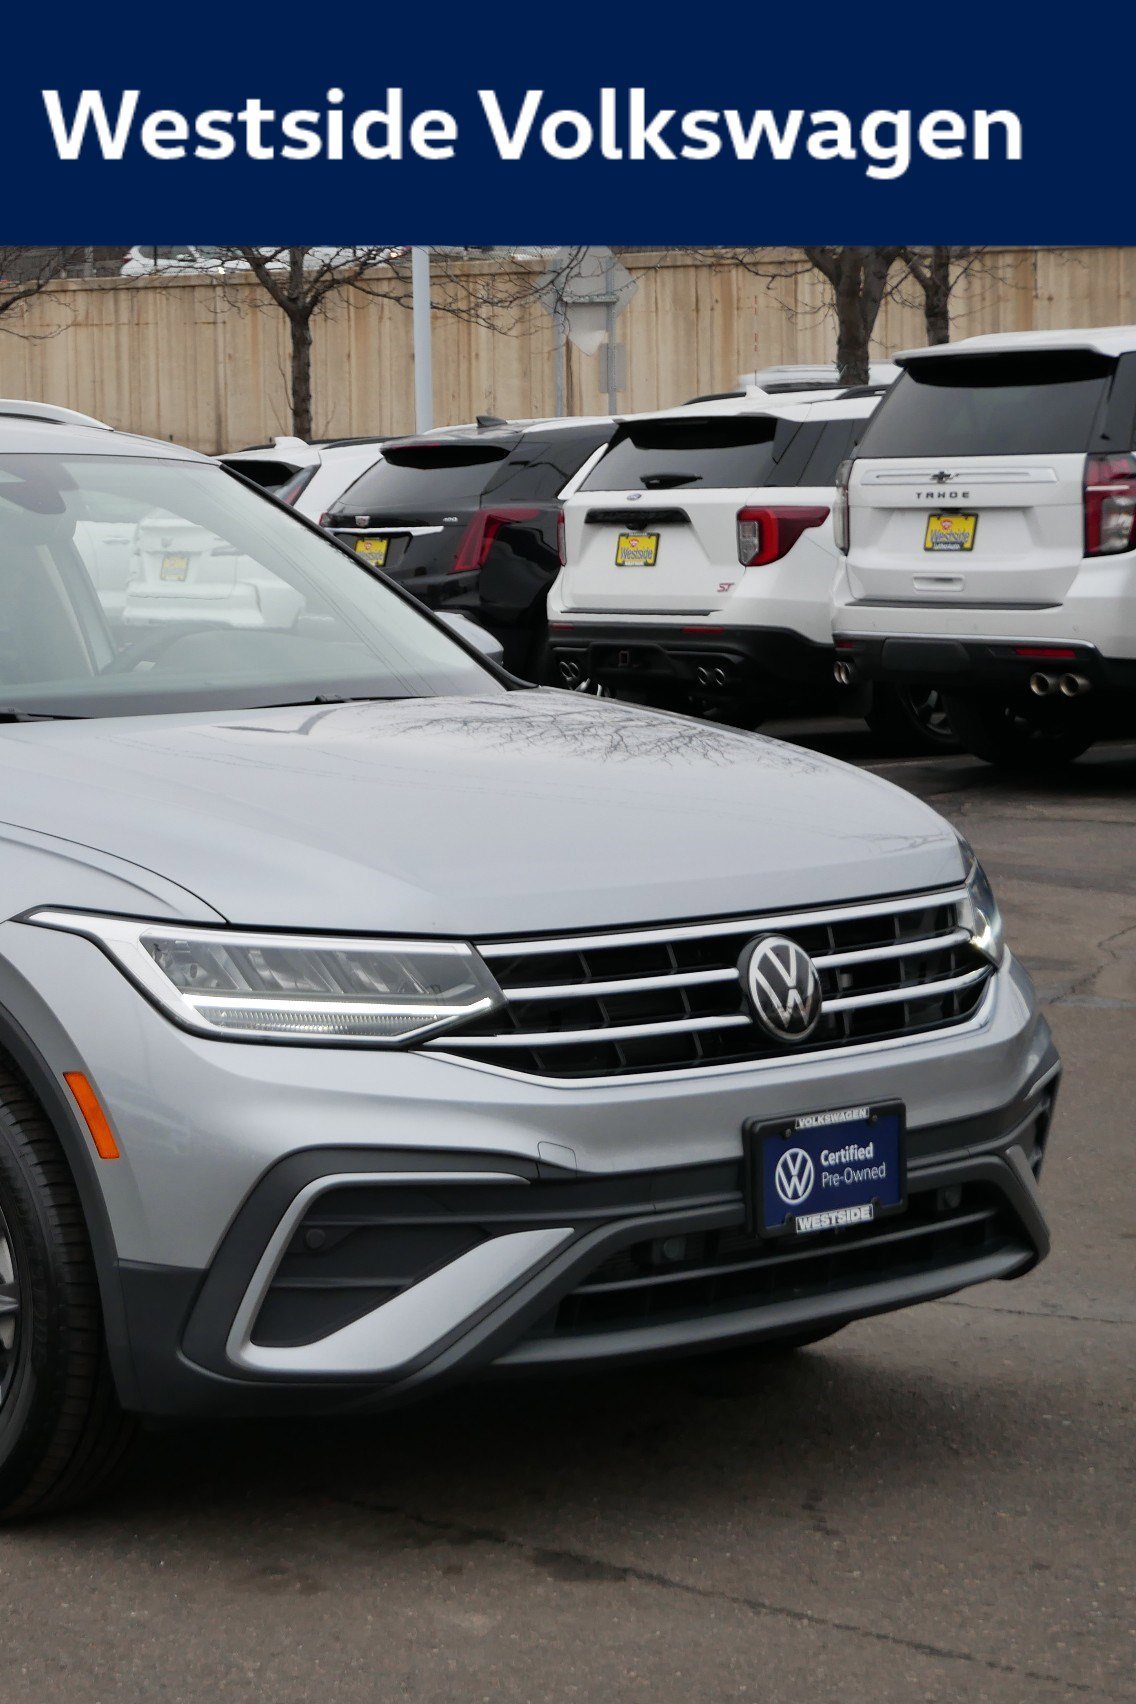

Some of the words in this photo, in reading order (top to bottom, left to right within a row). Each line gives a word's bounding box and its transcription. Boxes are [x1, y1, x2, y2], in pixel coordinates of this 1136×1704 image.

[916, 491, 970, 499] TAHOE
[717, 582, 735, 592] ST
[797, 1108, 868, 1128] VOLKSWAGEN
[820, 1142, 874, 1166] Certified
[775, 1147, 815, 1206] VW
[822, 1162, 887, 1187] Pre-Owned
[797, 1206, 873, 1231] WESTSIDE
